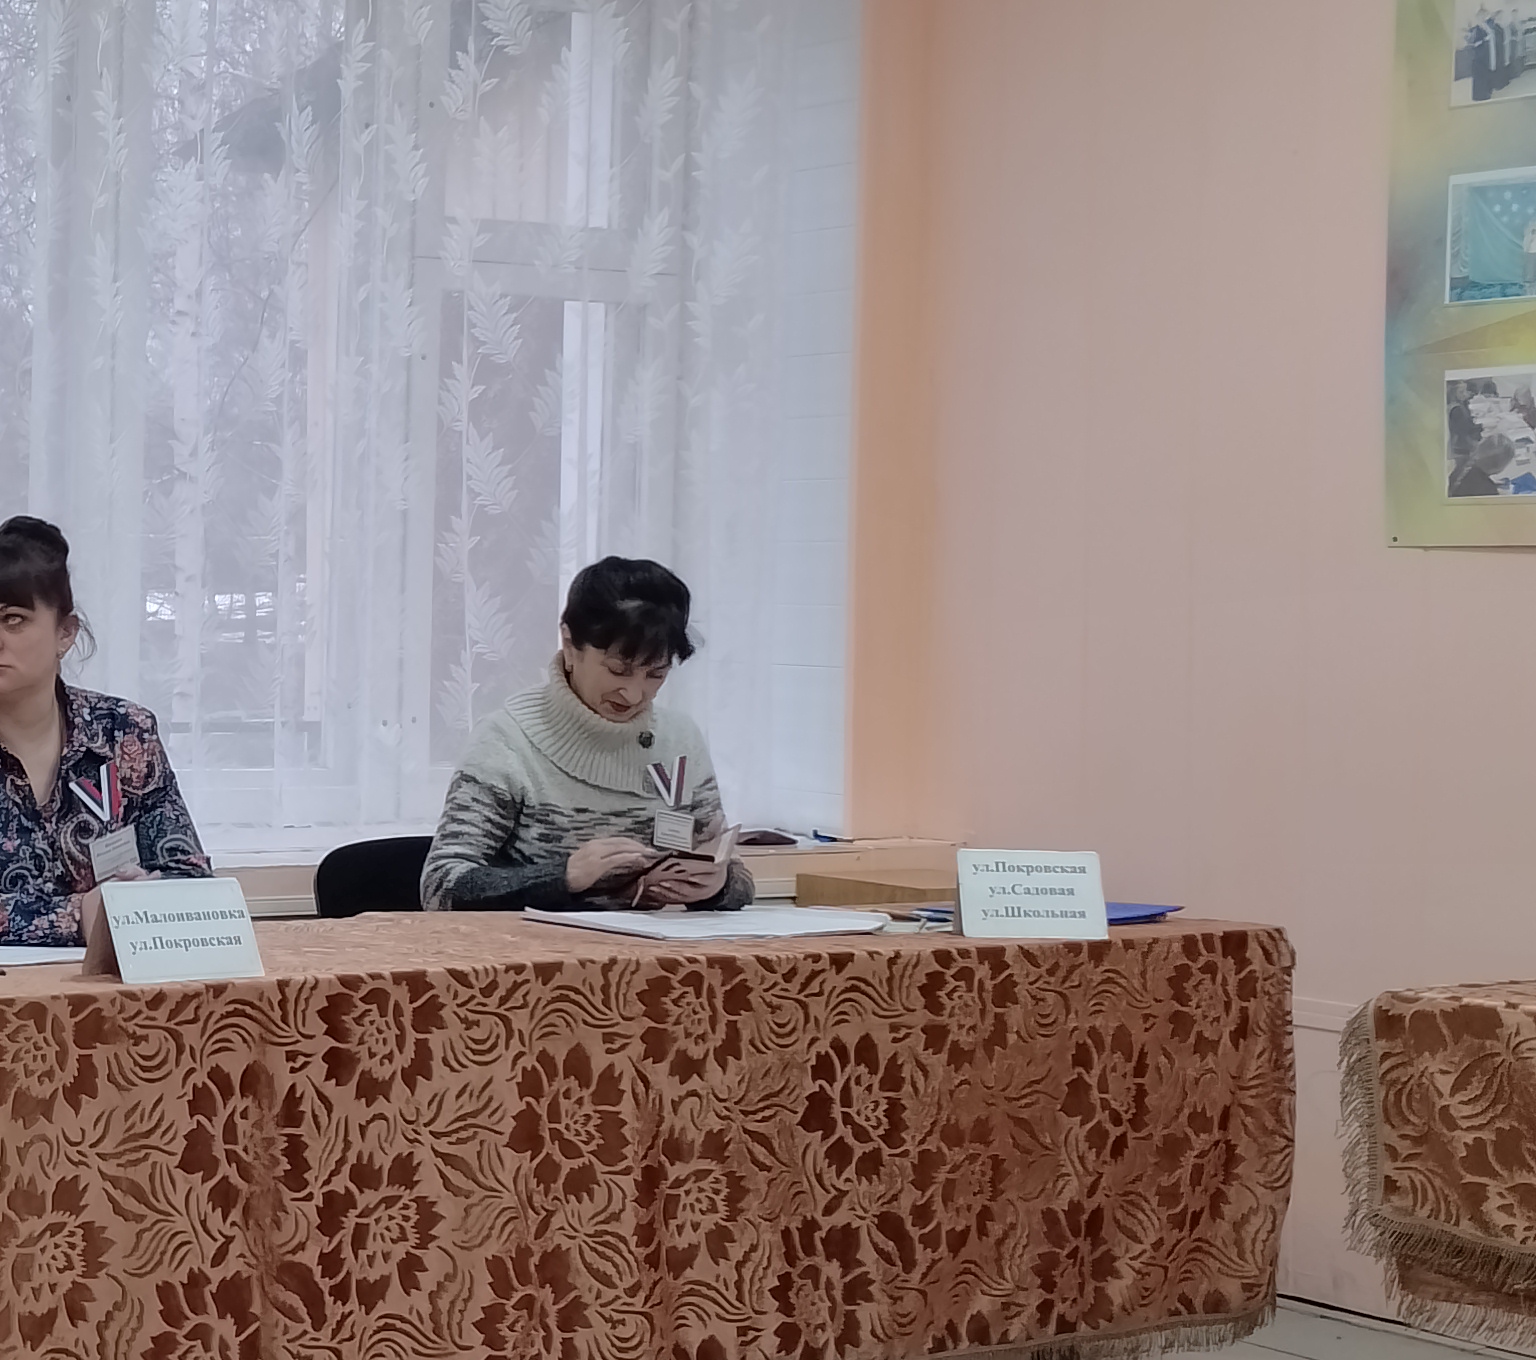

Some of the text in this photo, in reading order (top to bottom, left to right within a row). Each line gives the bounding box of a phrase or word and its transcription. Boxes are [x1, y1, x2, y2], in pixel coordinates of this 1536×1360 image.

[972, 861, 1087, 876] ул.Покровская
[988, 883, 1075, 898] ул.Садовая
[112, 908, 246, 930] ул.Малоивановка
[981, 905, 1086, 920] ул.Школьная
[129, 934, 242, 956] ул.Покровская
